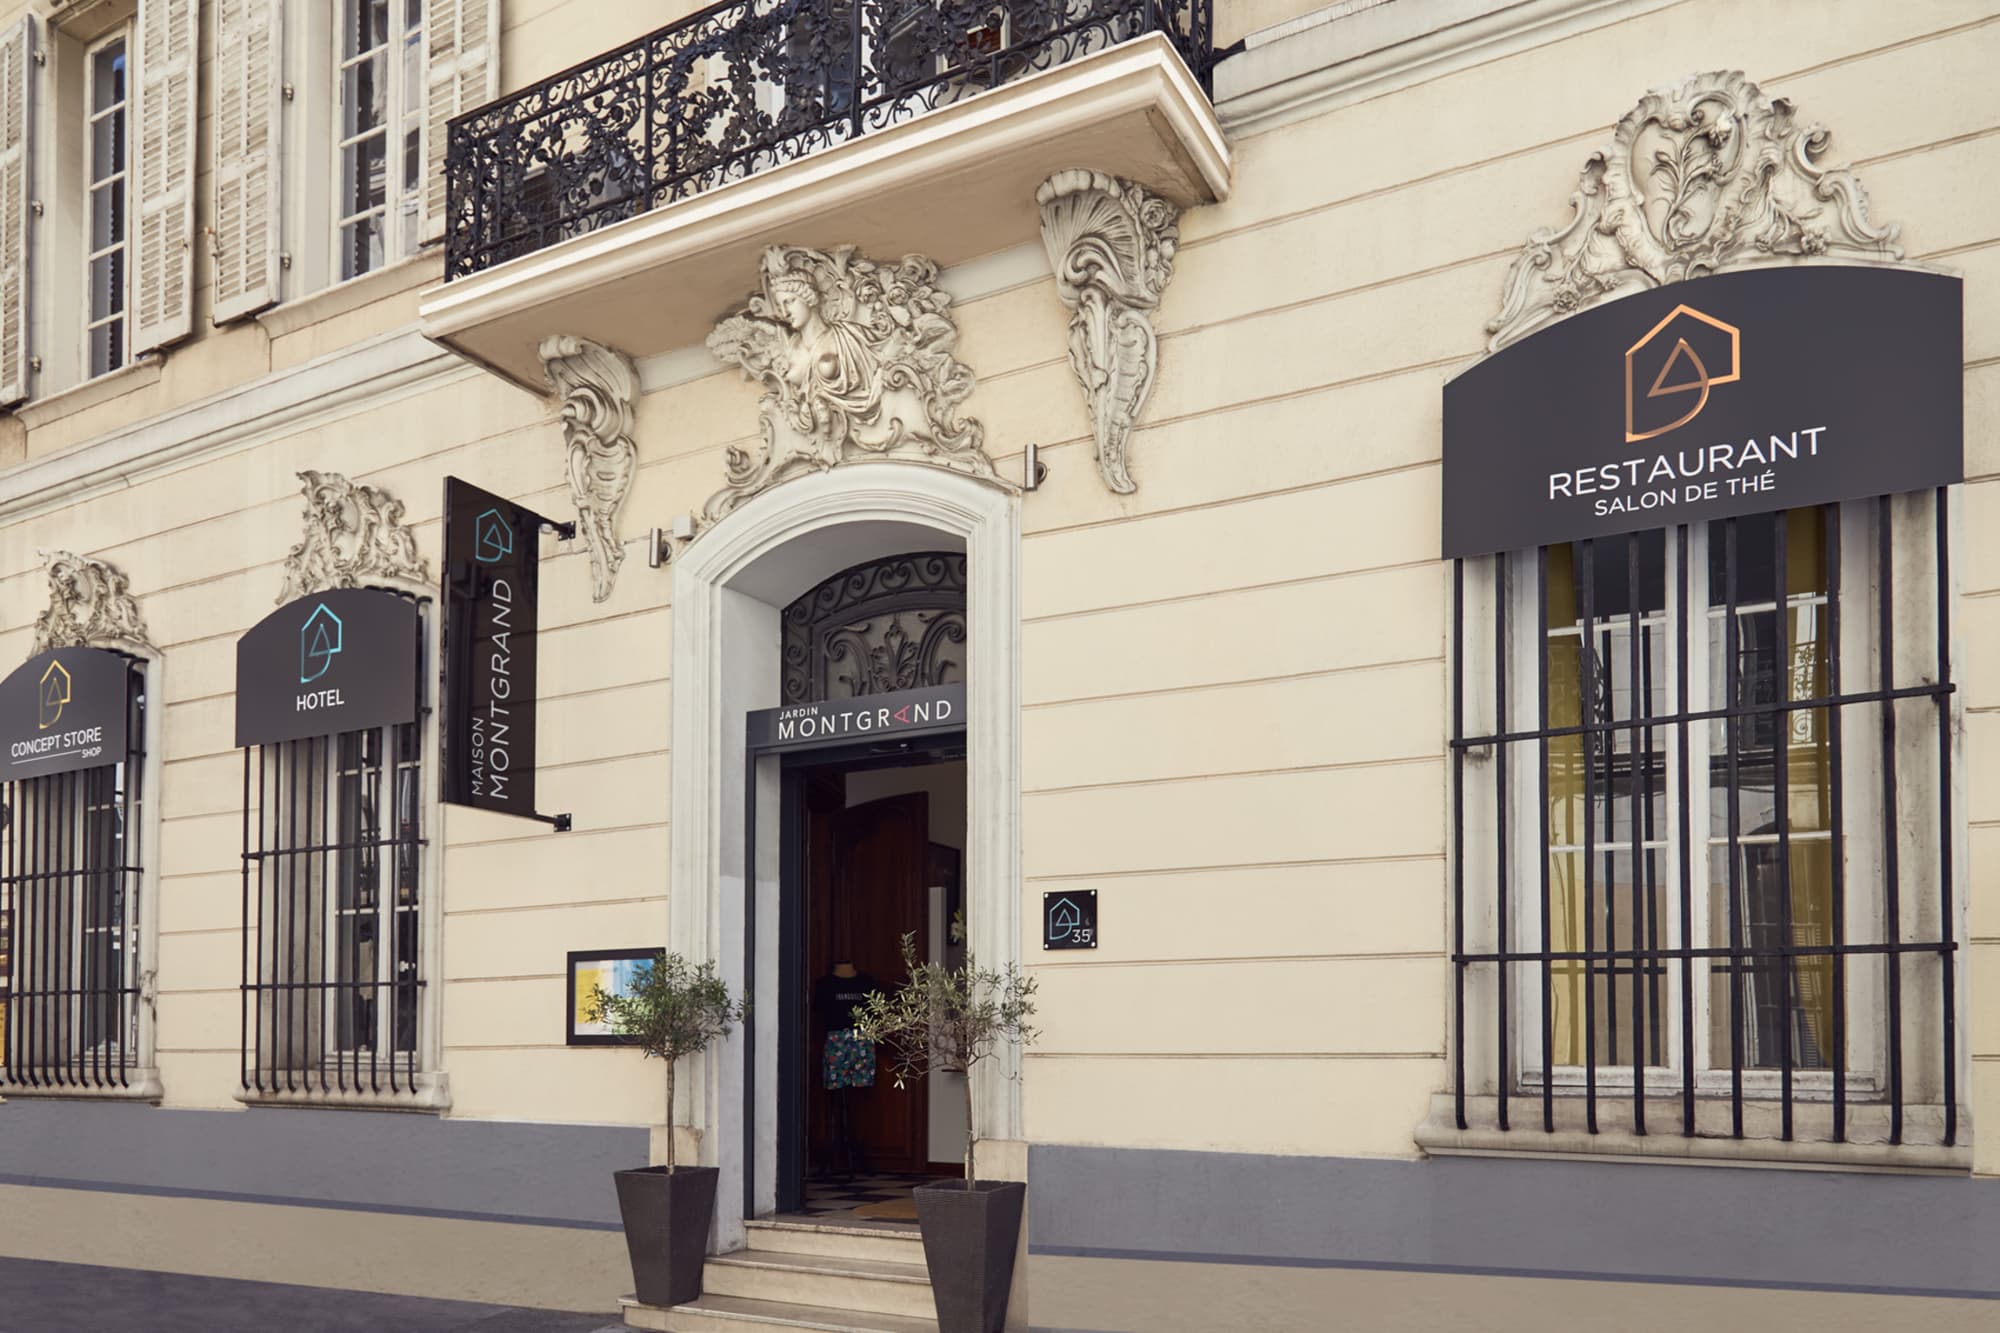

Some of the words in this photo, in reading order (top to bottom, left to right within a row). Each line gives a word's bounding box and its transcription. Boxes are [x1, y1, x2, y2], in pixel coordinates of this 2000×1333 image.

[1549, 426, 1827, 500] RESTAURANT
[1594, 488, 1676, 516] SALON
[1685, 481, 1718, 503] DE
[1726, 469, 1776, 496] THÉ
[296, 688, 345, 712] HOTEL
[490, 579, 512, 799] MONTGRAND
[778, 700, 951, 740] MONTGRAND
[779, 706, 819, 721] JARDIN
[11, 735, 61, 757] CONCEPT
[63, 727, 102, 748] STORE
[81, 746, 102, 759] SHOP
[471, 717, 484, 796] MAISON
[1071, 929, 1091, 943] 35
